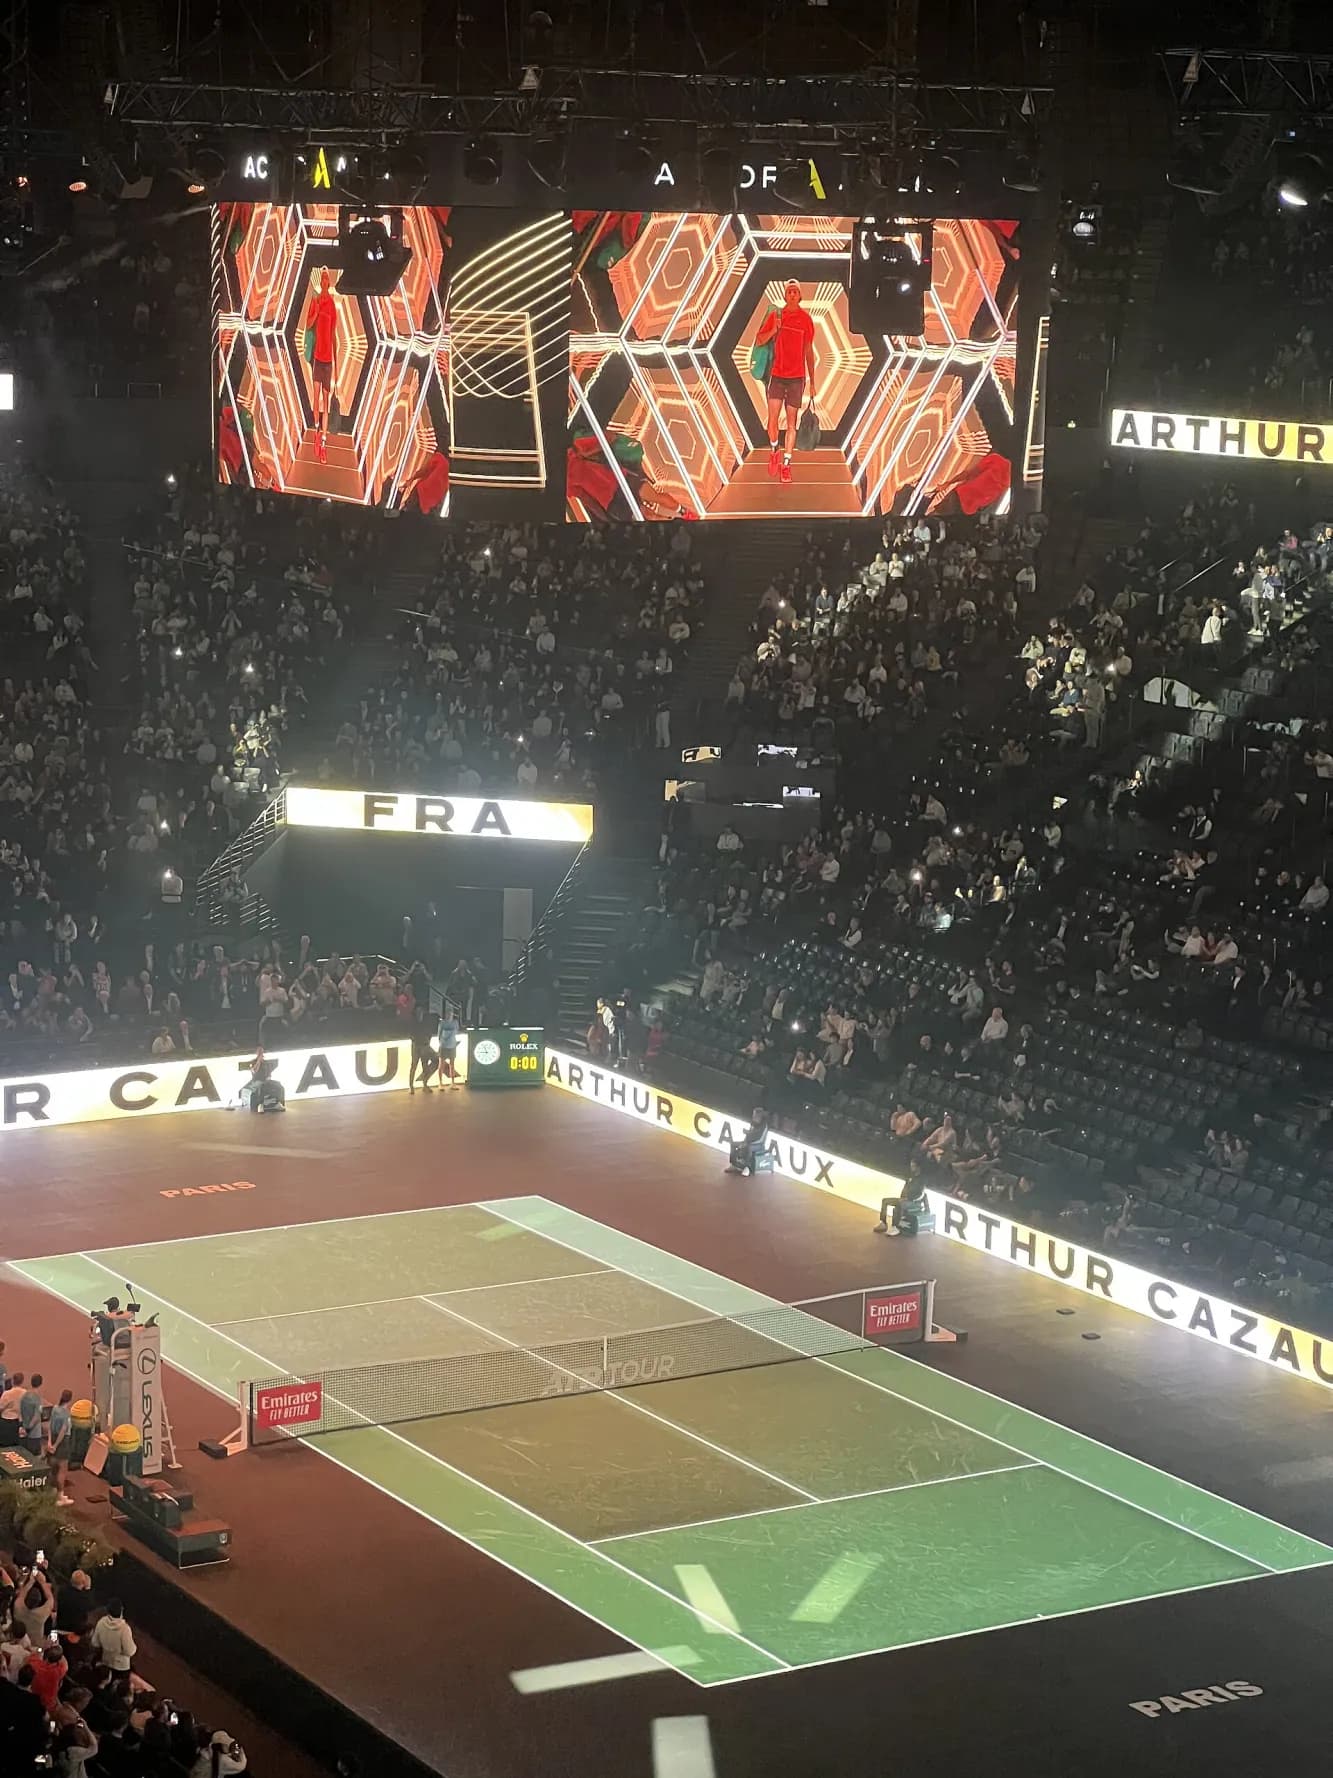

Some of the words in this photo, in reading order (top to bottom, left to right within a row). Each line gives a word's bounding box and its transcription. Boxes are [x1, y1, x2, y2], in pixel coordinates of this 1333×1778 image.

[1115, 412, 1326, 462] ARTHUR
[363, 794, 512, 836] FRA
[510, 1056, 537, 1070] 0:00
[546, 1055, 674, 1126] ARTHUR
[159, 1181, 257, 1198] PARIS
[869, 1300, 918, 1317] Emirates
[876, 1316, 889, 1328] FLY
[888, 1313, 911, 1326] BETTER
[605, 1355, 674, 1386] TOUR
[261, 1390, 318, 1410] Emirates
[269, 1408, 283, 1421] FLY
[283, 1403, 311, 1419] BETTER
[142, 1380, 153, 1459] LEXUS
[1127, 1680, 1264, 1718] PARIS
